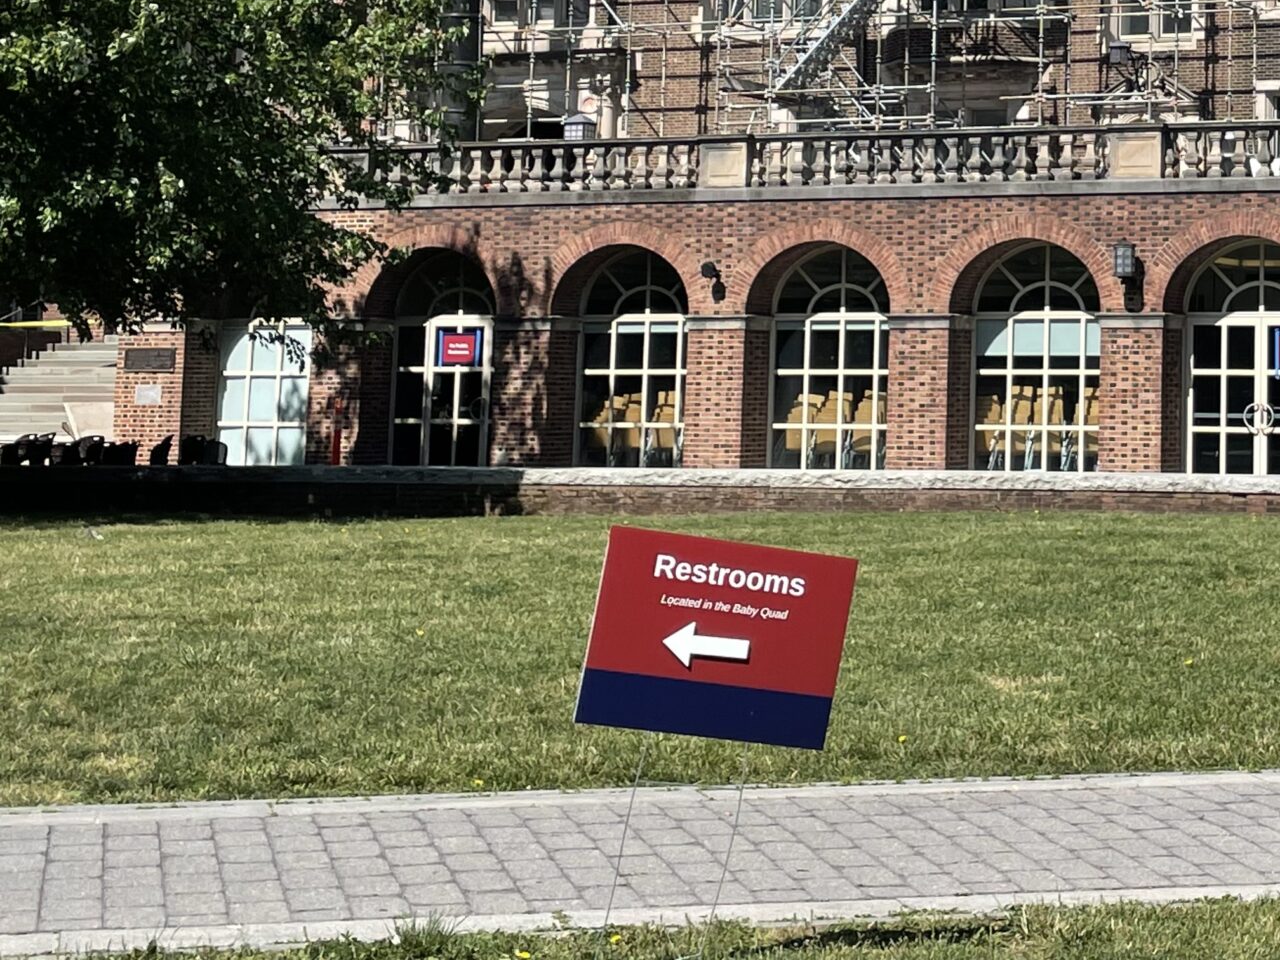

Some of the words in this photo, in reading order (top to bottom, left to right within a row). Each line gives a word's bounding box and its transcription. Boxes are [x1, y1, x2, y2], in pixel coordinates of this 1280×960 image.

[653, 553, 806, 597] Restrooms
[660, 593, 702, 609] Located
[702, 599, 713, 610] in
[714, 601, 731, 612] the
[732, 603, 759, 618] Baby
[760, 607, 789, 620] Quad
